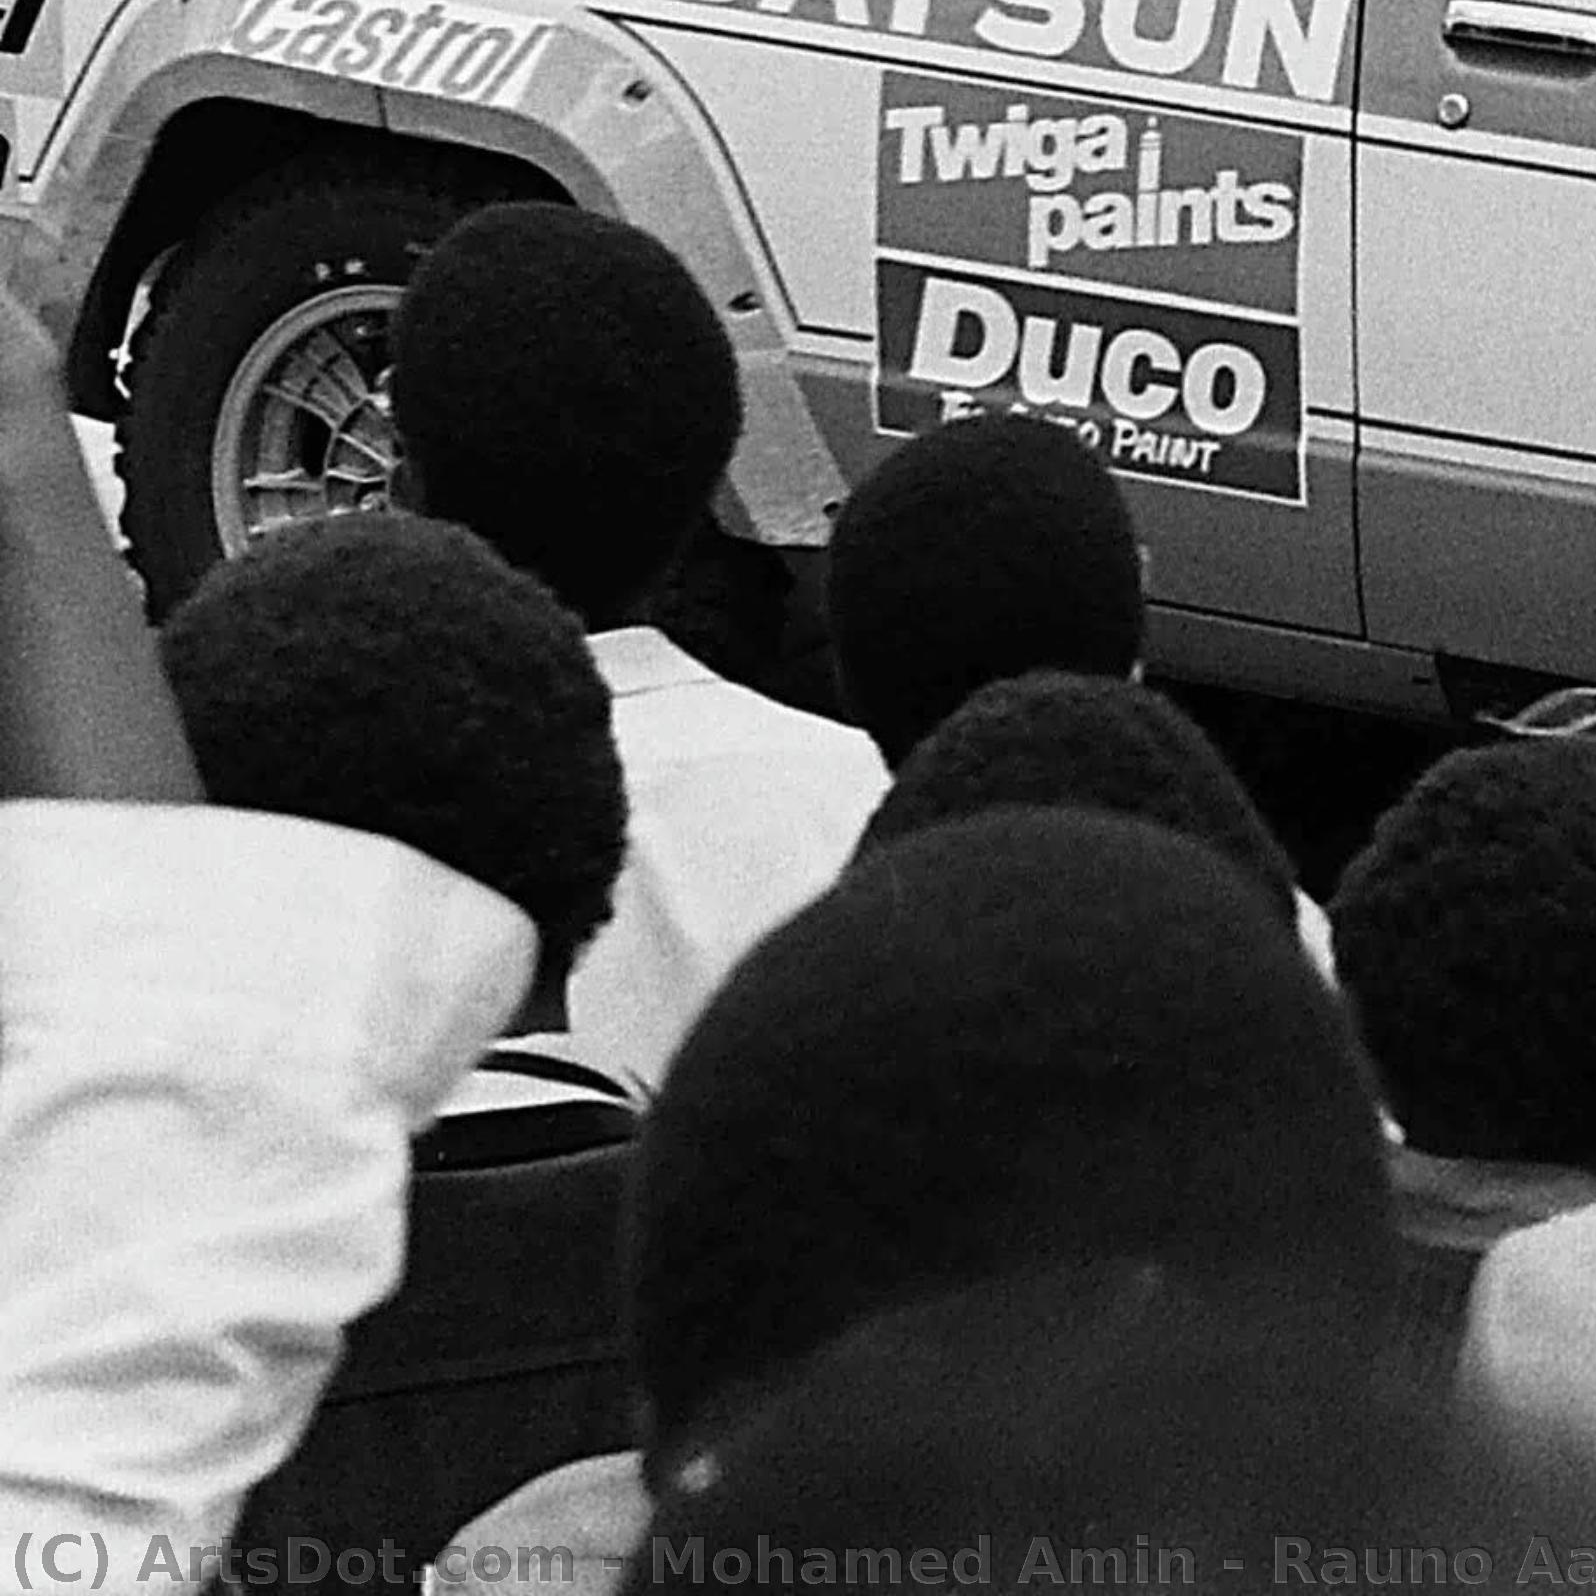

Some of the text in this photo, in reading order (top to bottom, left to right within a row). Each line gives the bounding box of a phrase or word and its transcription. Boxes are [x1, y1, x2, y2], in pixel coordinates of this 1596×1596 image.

[884, 103, 1129, 191] Twiga
[1028, 114, 1295, 268] paints
[1111, 417, 1221, 474] PAINT
